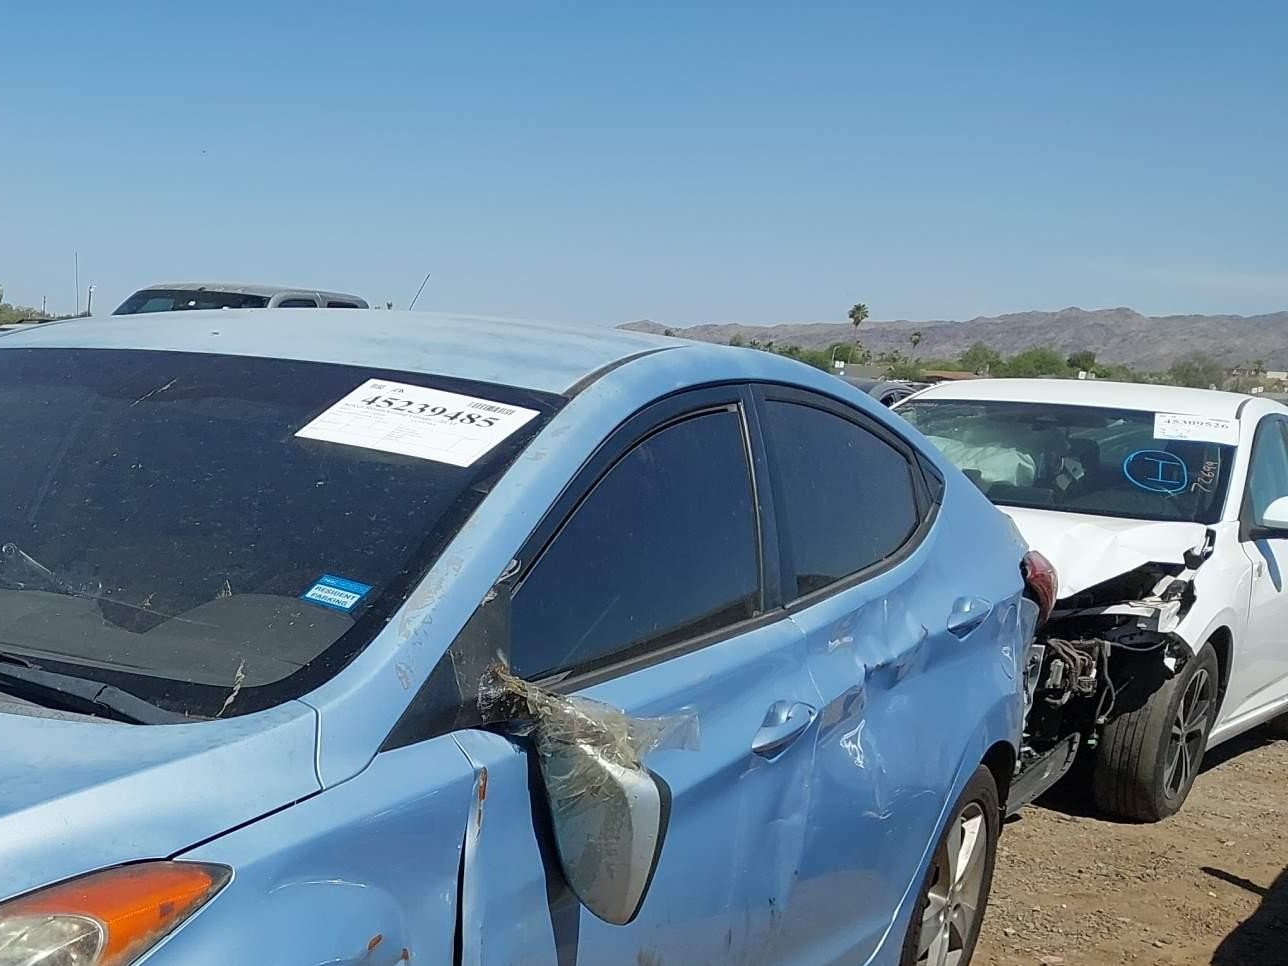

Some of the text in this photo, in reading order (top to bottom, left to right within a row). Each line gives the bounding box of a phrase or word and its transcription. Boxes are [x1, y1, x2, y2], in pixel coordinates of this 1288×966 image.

[360, 395, 502, 428] 45239485
[310, 592, 349, 606] PARKING
[314, 586, 356, 600] RESIDENT
